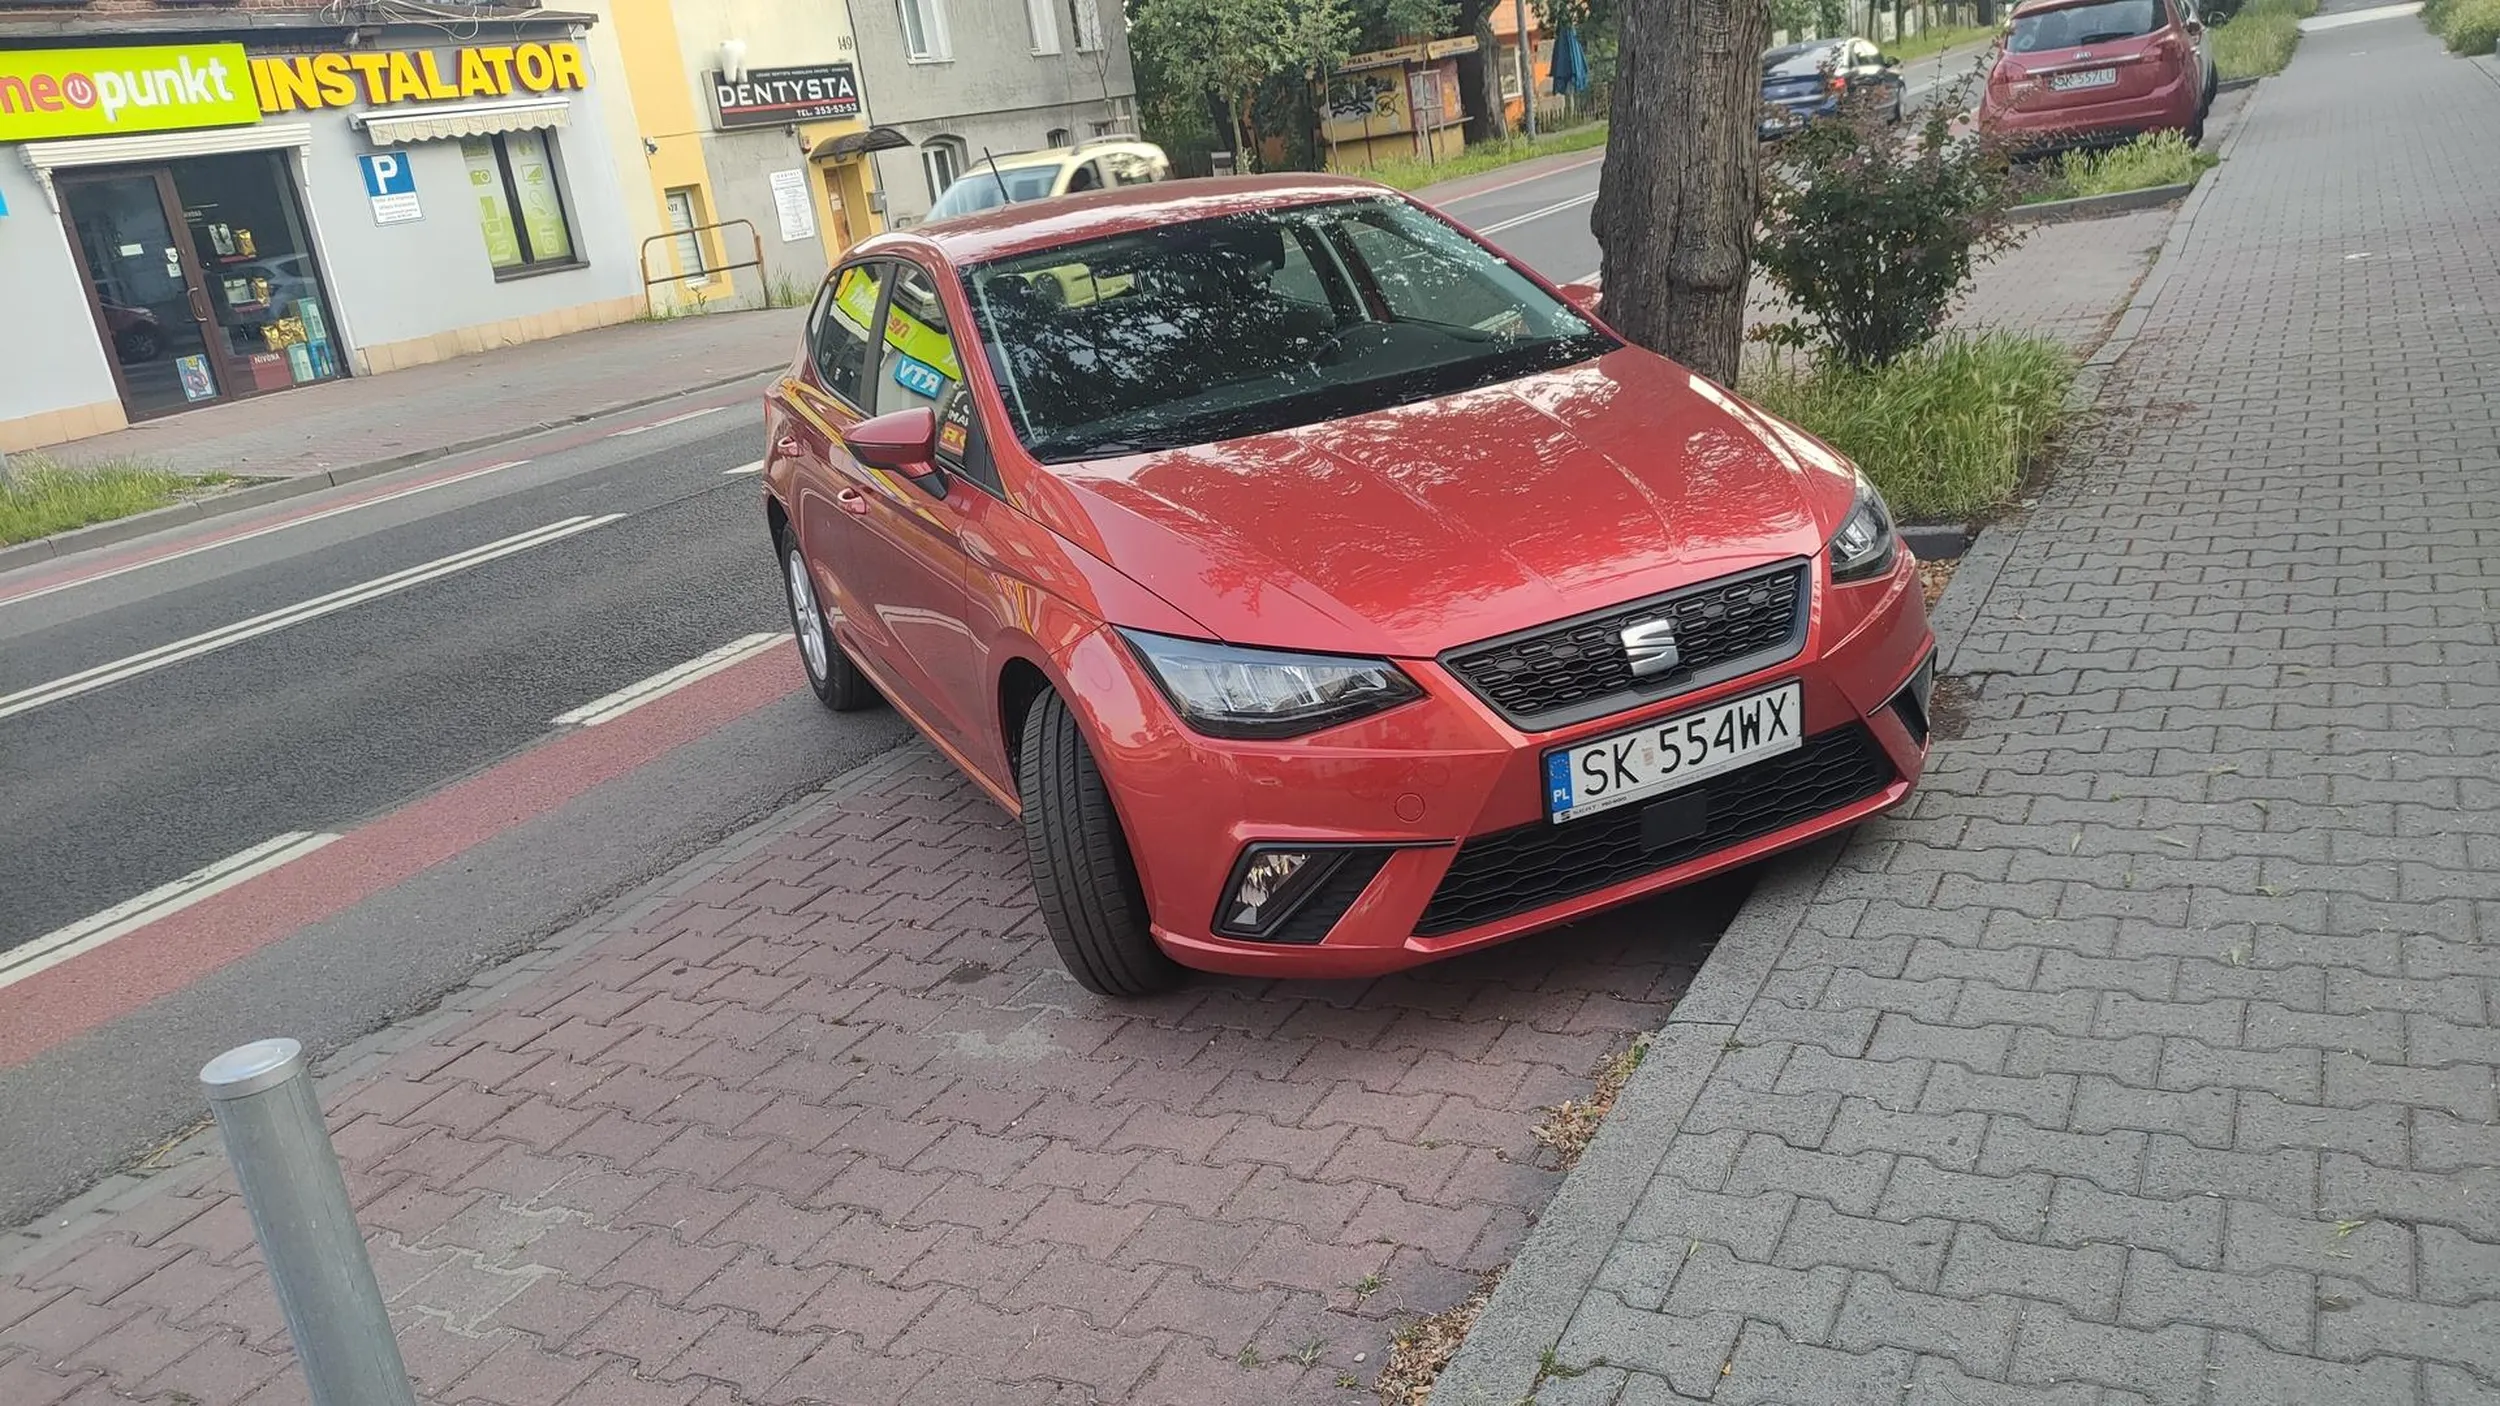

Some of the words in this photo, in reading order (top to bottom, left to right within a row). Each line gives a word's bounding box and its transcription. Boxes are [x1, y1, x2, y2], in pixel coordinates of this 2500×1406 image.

[250, 42, 588, 113] INSTALATOR
[718, 76, 854, 107] DENTYSTA
[796, 108, 813, 117] TEL.
[814, 103, 858, 115] 353-53-53
[371, 155, 398, 194] P
[1581, 737, 1640, 796] SK
[1659, 691, 1789, 774] 554WX
[1553, 788, 1570, 803] PL
